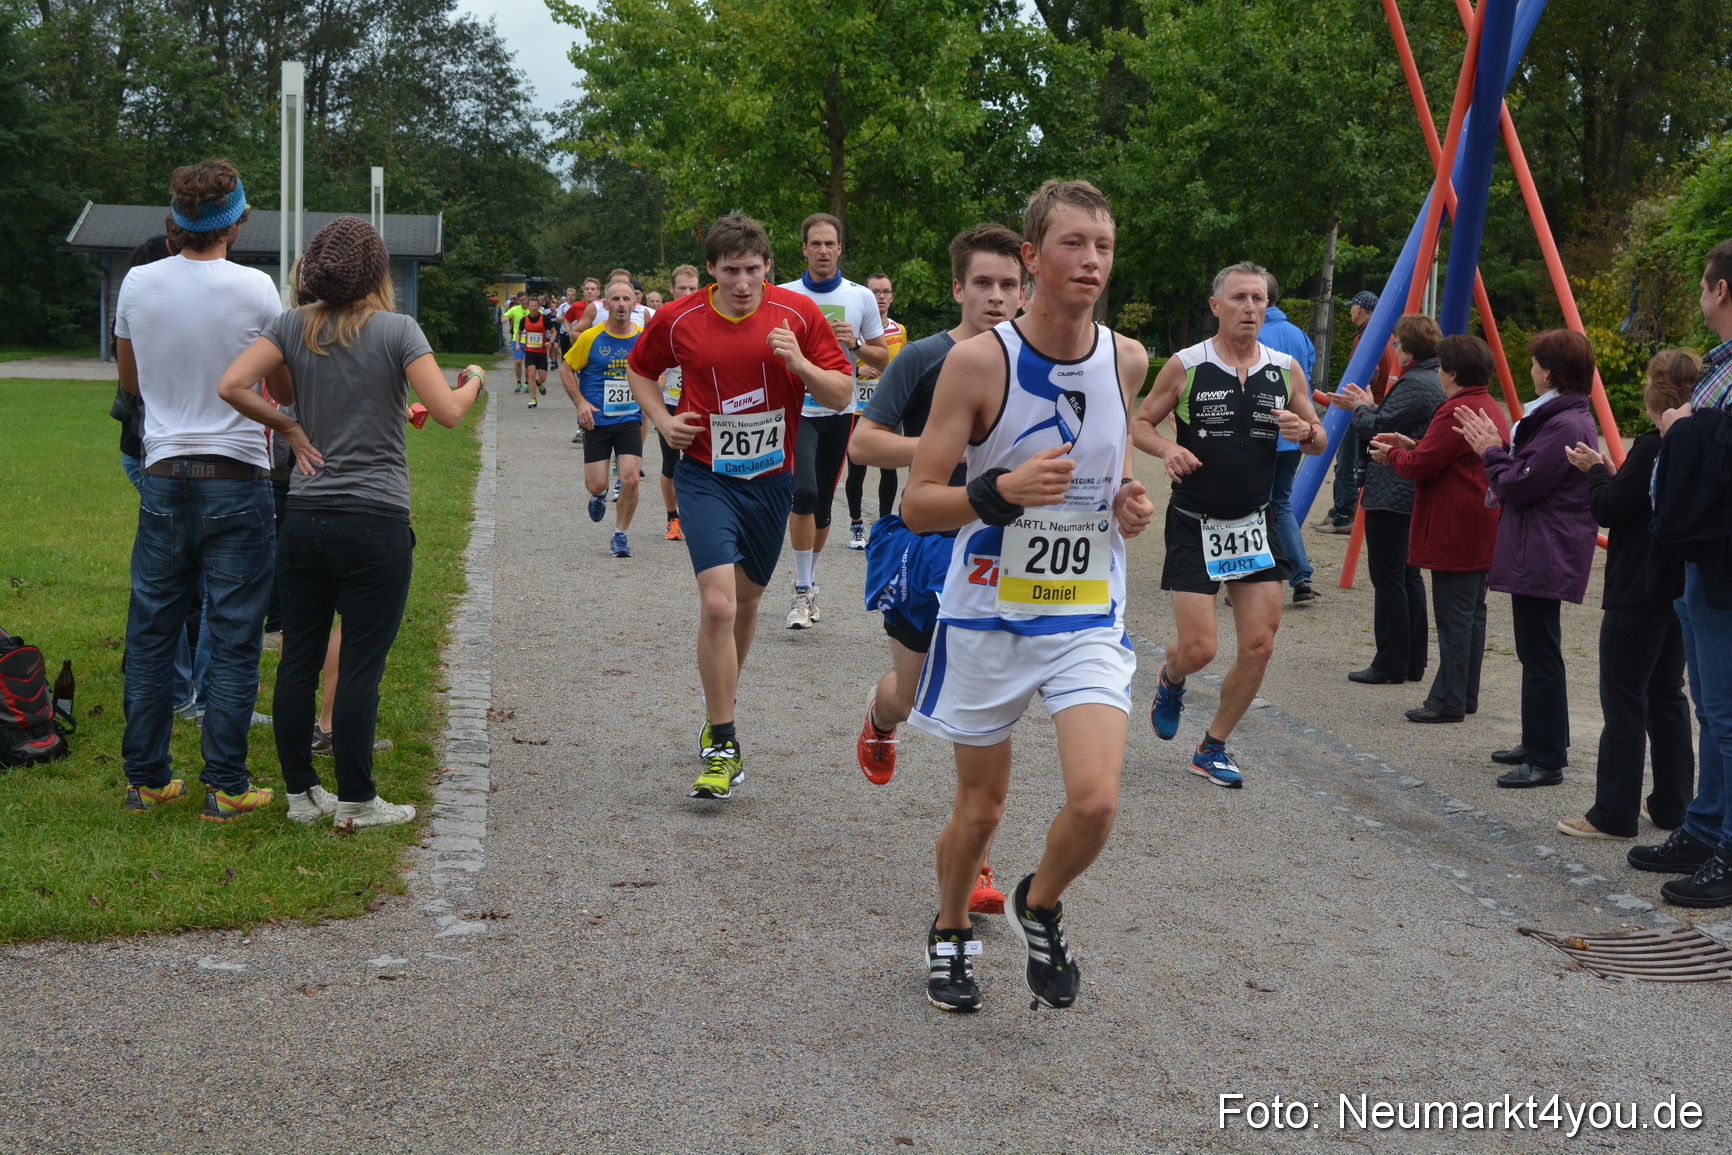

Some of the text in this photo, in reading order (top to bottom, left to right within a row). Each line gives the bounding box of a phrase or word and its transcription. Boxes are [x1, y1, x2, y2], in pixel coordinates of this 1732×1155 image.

[733, 396, 753, 408] DEHN
[859, 388, 874, 400] 20
[1069, 396, 1082, 413] RSC
[712, 418, 772, 428] PARTL Neumarkt
[720, 426, 778, 456] 2674
[171, 463, 216, 478] PMA
[725, 456, 774, 473] Carl-Jonas
[1009, 518, 1095, 532] PARTL Neumarkt
[1209, 528, 1263, 558] 3410
[1025, 536, 1090, 575] 209
[968, 558, 999, 586] ZE
[1218, 558, 1256, 574] KURT
[1032, 585, 1076, 600] Daniel
